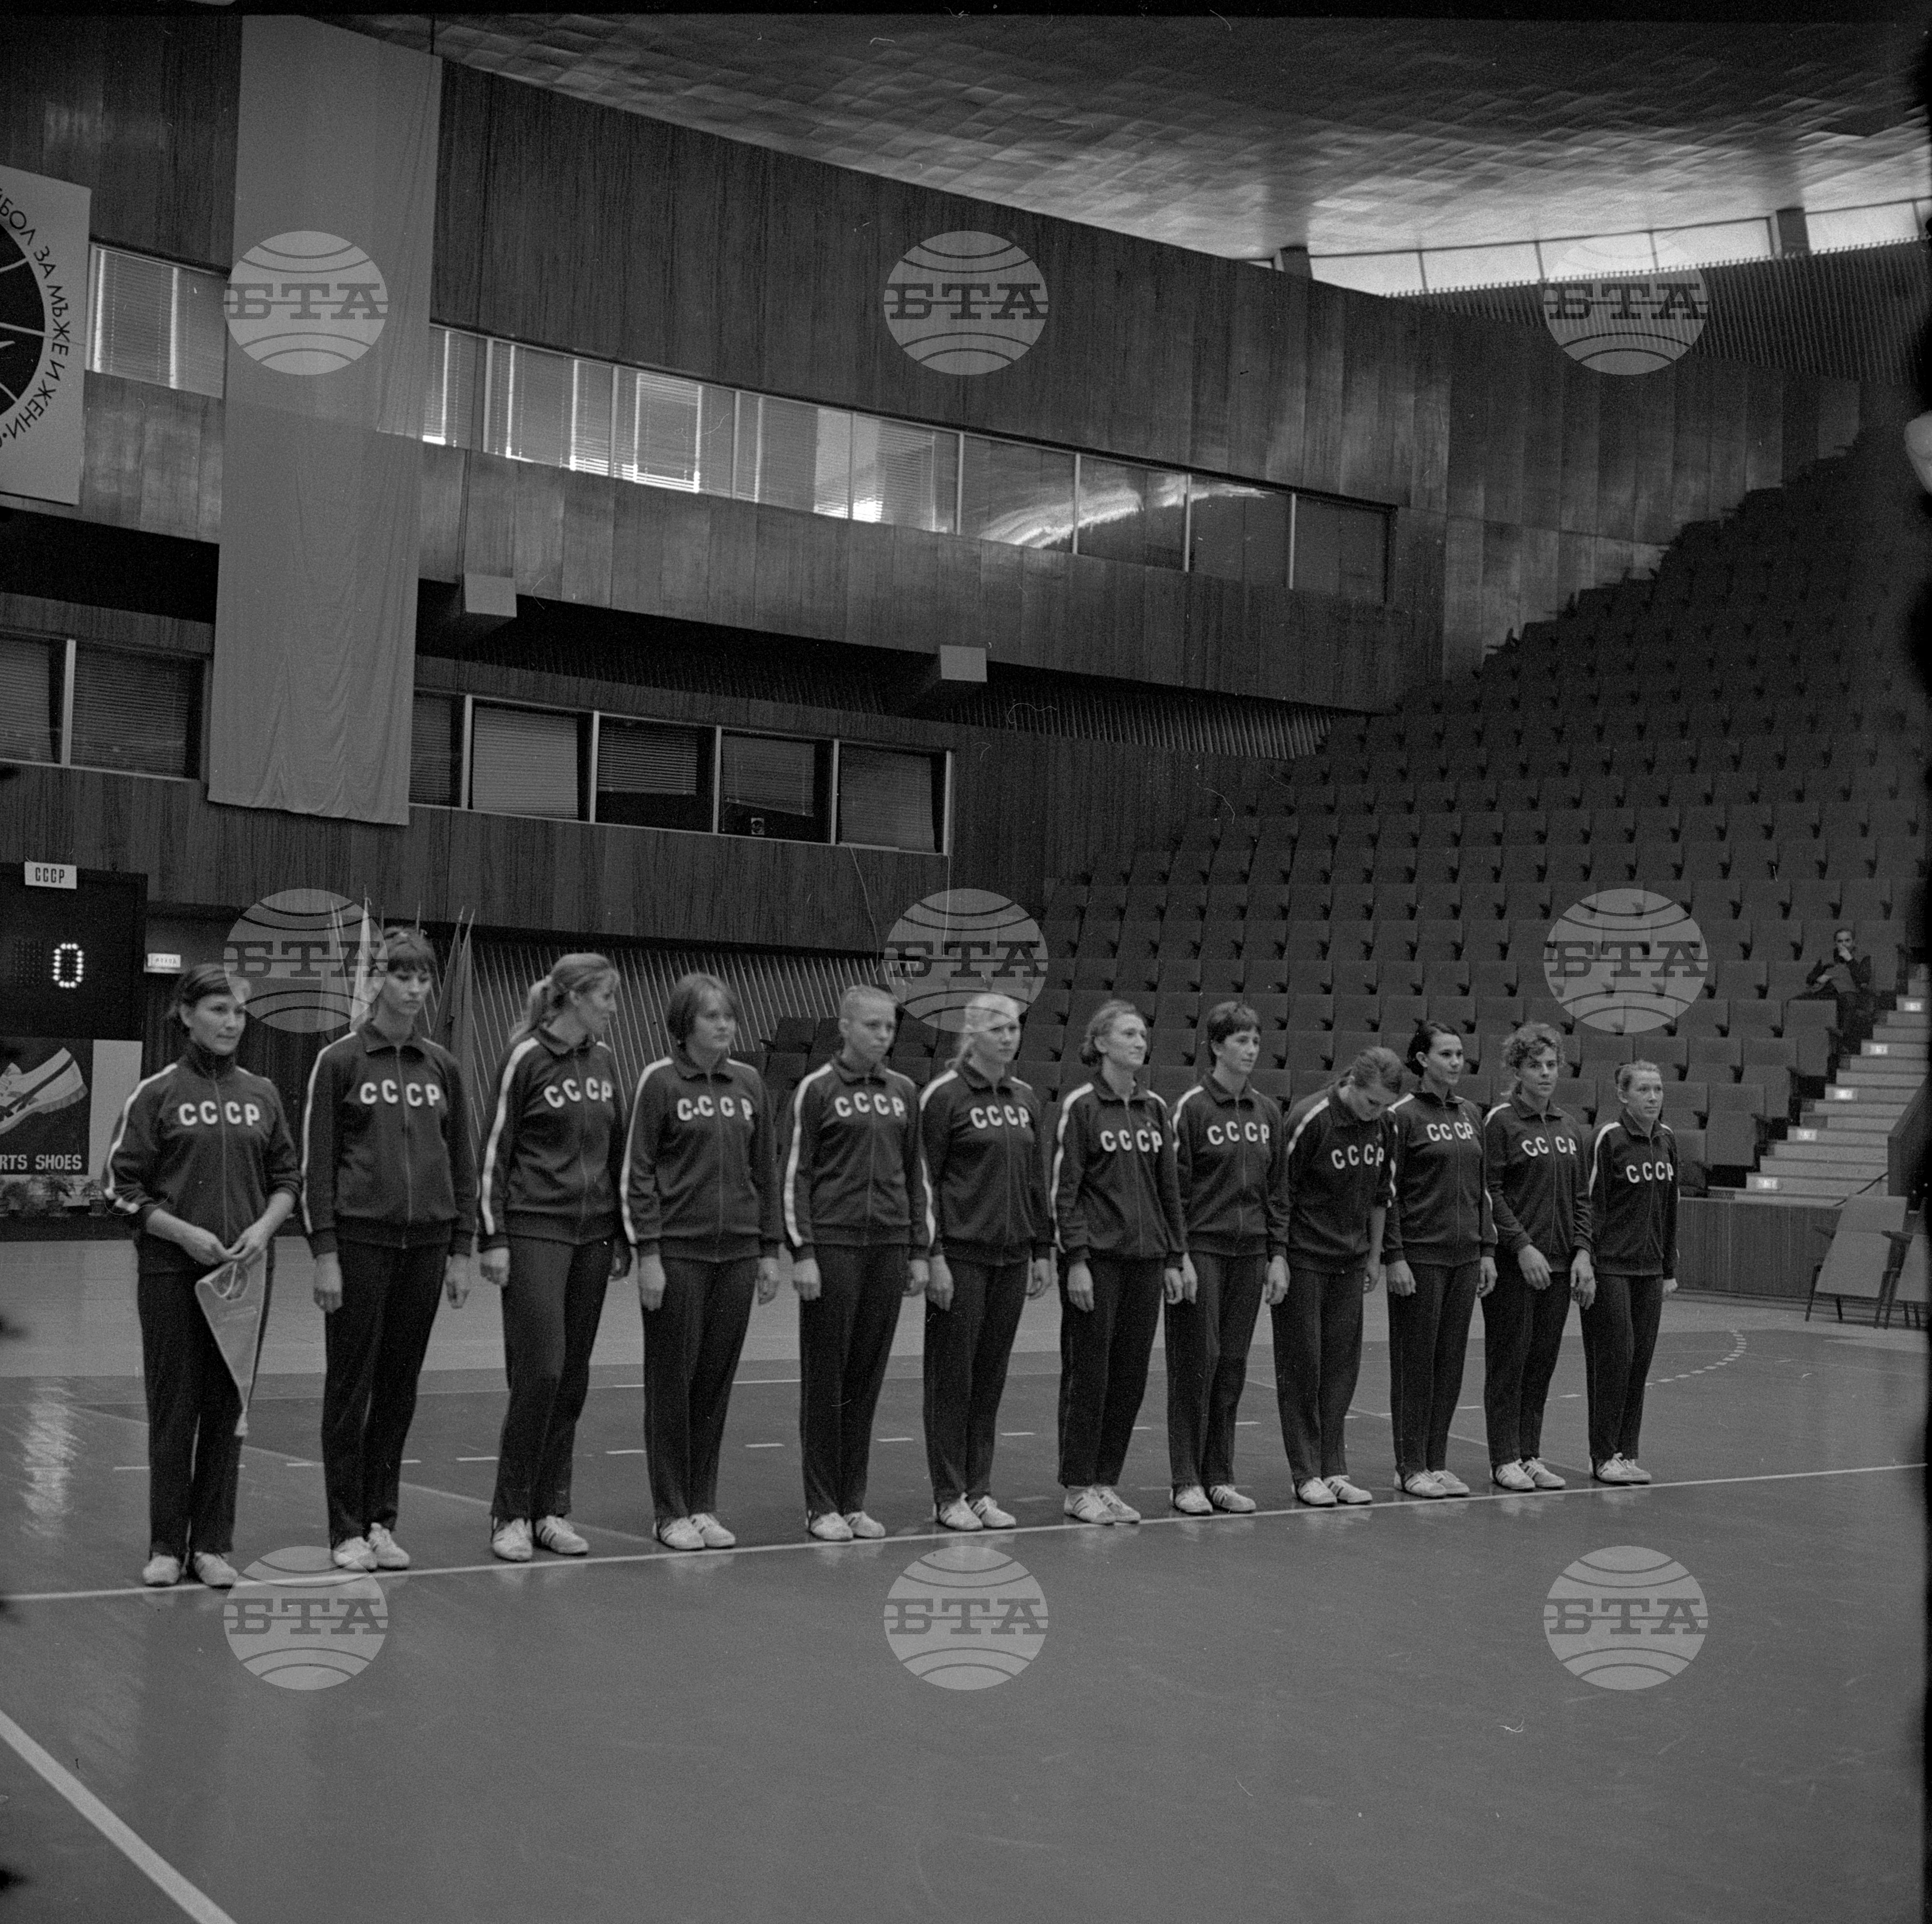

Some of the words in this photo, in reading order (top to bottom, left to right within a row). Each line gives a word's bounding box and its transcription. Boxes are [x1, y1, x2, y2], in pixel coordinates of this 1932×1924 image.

[0, 186, 36, 245] БОЛ
[33, 245, 57, 279] ЗА
[46, 285, 70, 356] МЪЖЕ
[45, 359, 65, 381] И
[5, 379, 57, 439] ЖЕНИ
[35, 867, 65, 884] СССР
[52, 943, 85, 989] 0
[360, 1079, 440, 1106] СССР
[544, 1077, 612, 1108] СССР
[834, 1092, 905, 1117] СССР
[179, 1101, 260, 1126] СССР
[677, 1095, 753, 1120] СССР
[969, 1105, 1029, 1128] СССР
[1100, 1130, 1163, 1153] СССР
[1207, 1121, 1269, 1145] СССР
[1426, 1121, 1473, 1142] СССР
[1331, 1144, 1384, 1169] СССР
[1521, 1136, 1577, 1157] СССР
[35, 1154, 82, 1170] SHOES
[1626, 1161, 1674, 1183] СССР
